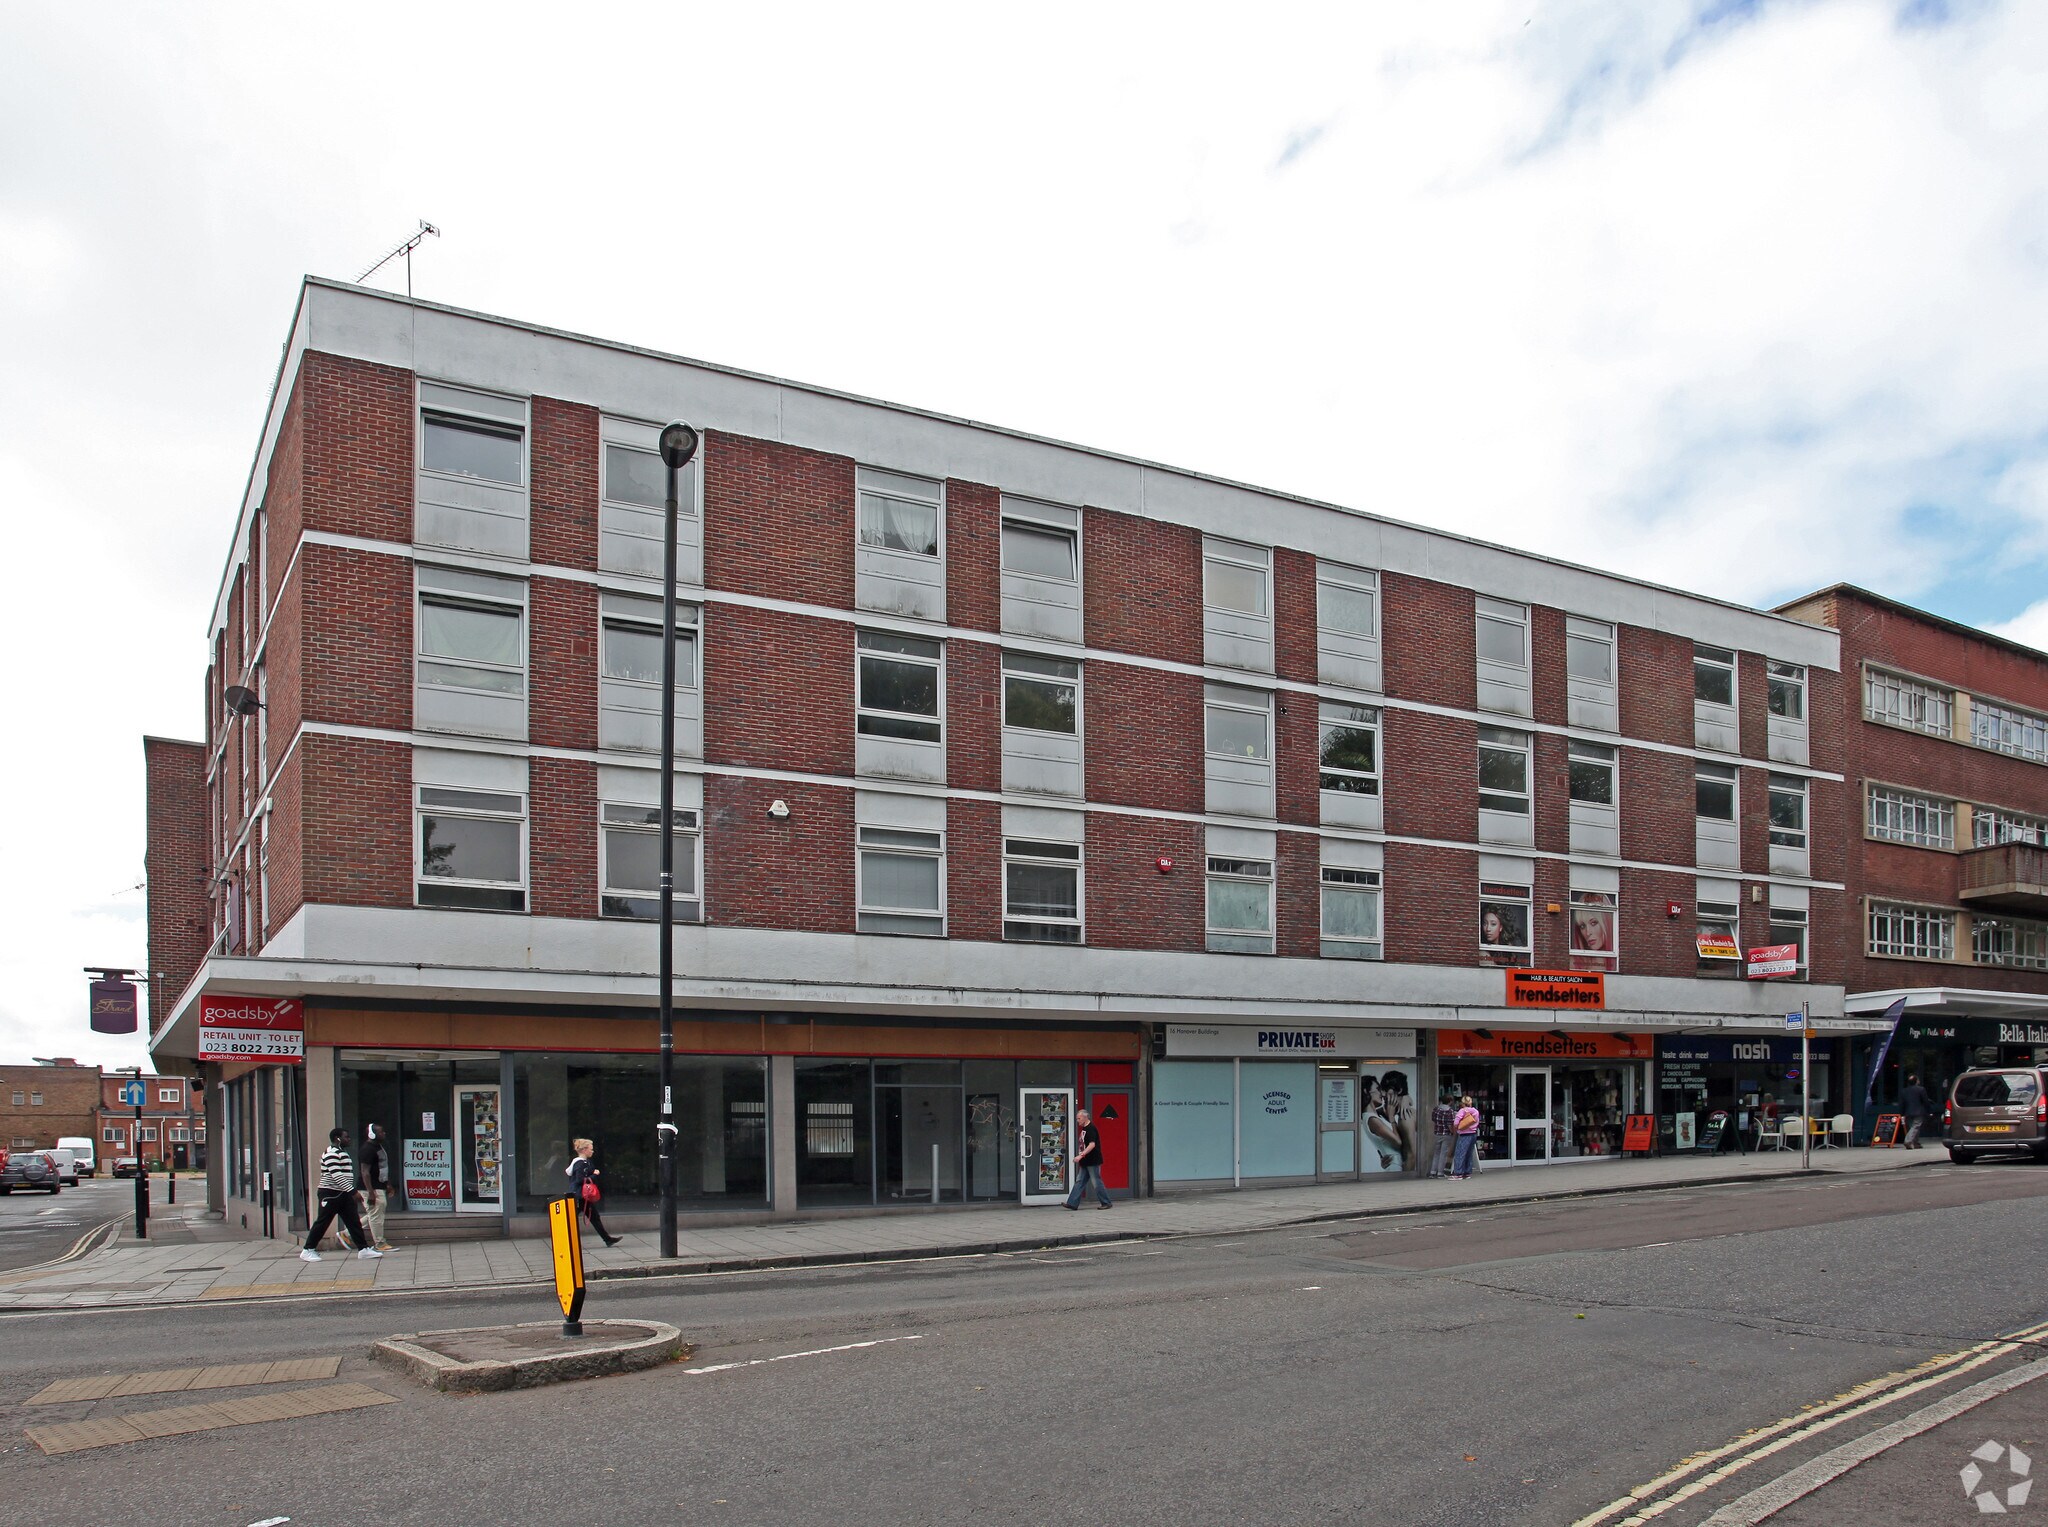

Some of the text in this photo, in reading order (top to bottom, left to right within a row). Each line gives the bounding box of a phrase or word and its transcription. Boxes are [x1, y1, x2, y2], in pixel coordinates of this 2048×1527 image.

[1750, 950, 1783, 962] goadsby
[1514, 986, 1600, 1004] trendsetters
[92, 998, 134, 1013] Strand
[204, 1006, 278, 1026] goadsby
[1258, 1032, 1319, 1048] PRIVATE
[1999, 1024, 2025, 1042] Bella
[206, 1042, 297, 1054] 023 8022 7337
[1501, 1036, 1597, 1054] trendsetters
[1733, 1038, 1770, 1059] nosh
[1263, 1091, 1291, 1100] LICENSED
[410, 1151, 444, 1160] TO LET
[409, 1186, 440, 1196] goadsby
